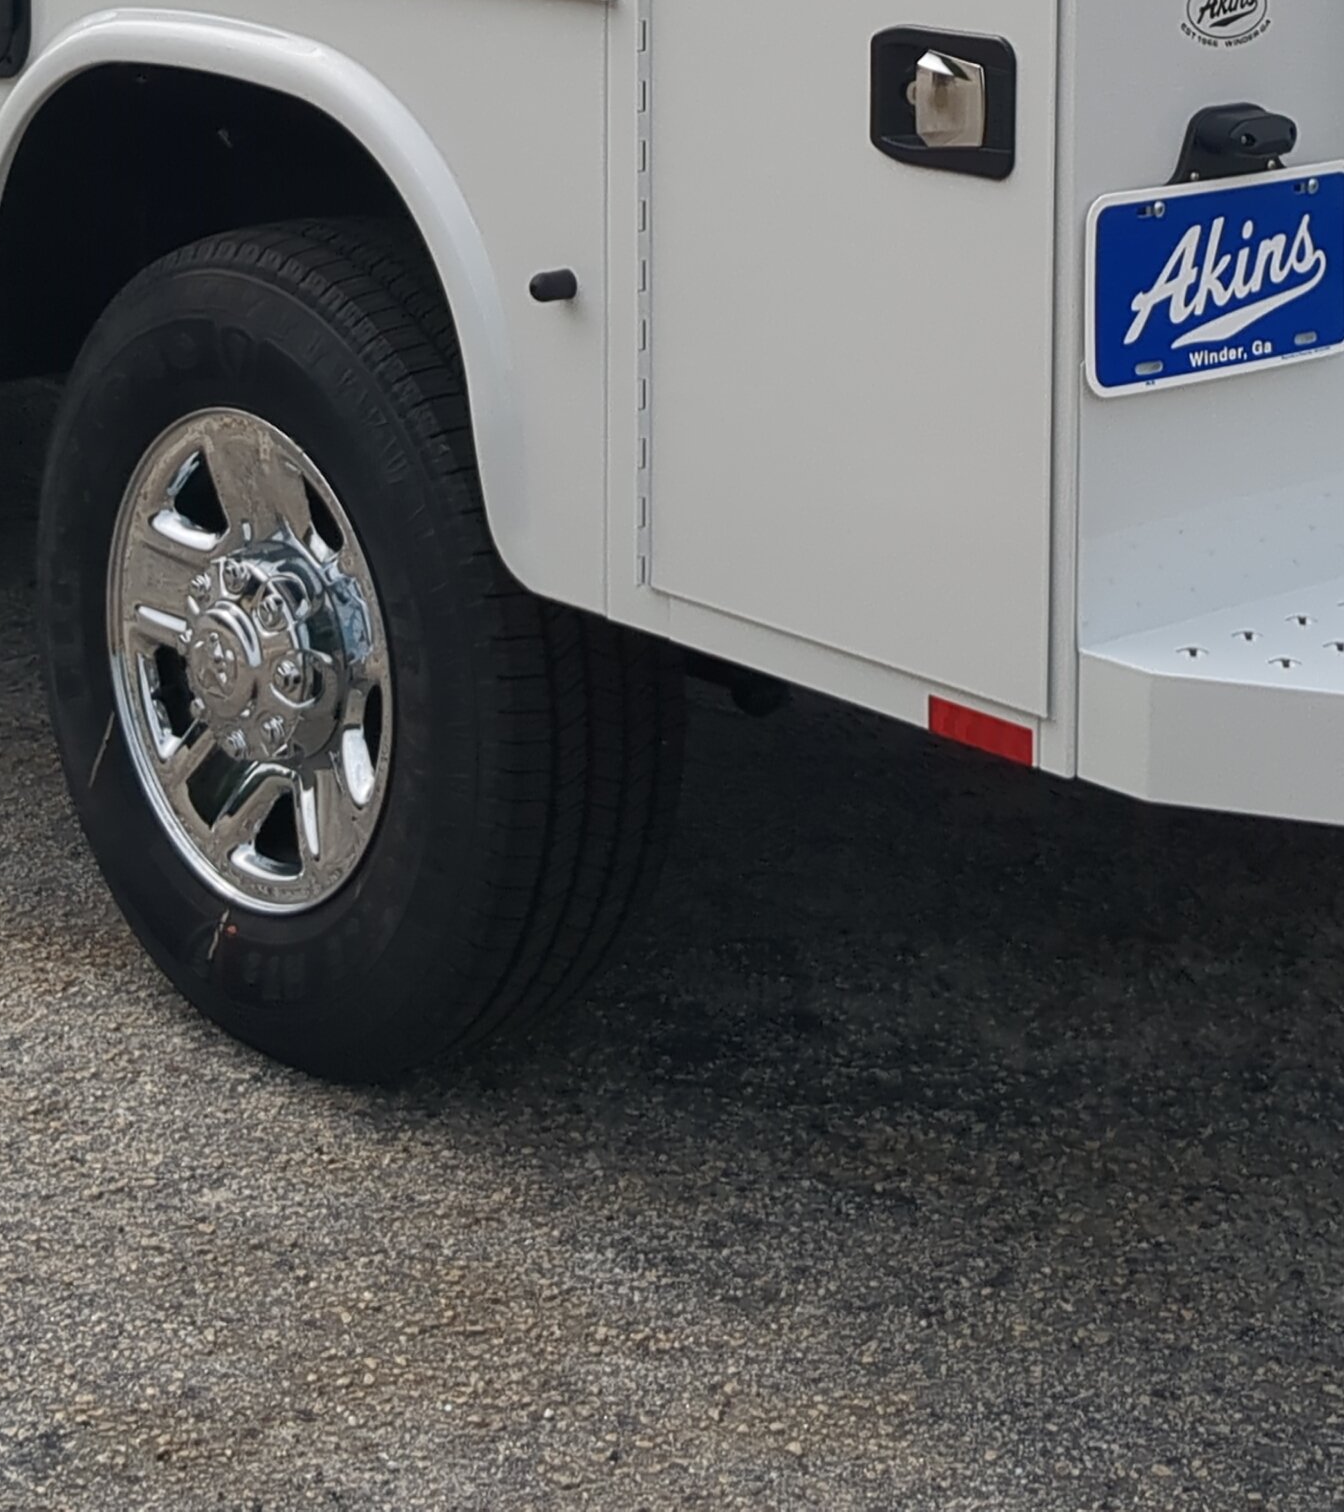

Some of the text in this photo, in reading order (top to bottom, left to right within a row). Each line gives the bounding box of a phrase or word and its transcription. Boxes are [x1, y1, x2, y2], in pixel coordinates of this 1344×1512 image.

[1123, 214, 1326, 349] Akins
[1189, 346, 1247, 368] Winder,
[1252, 340, 1272, 356] Ga
